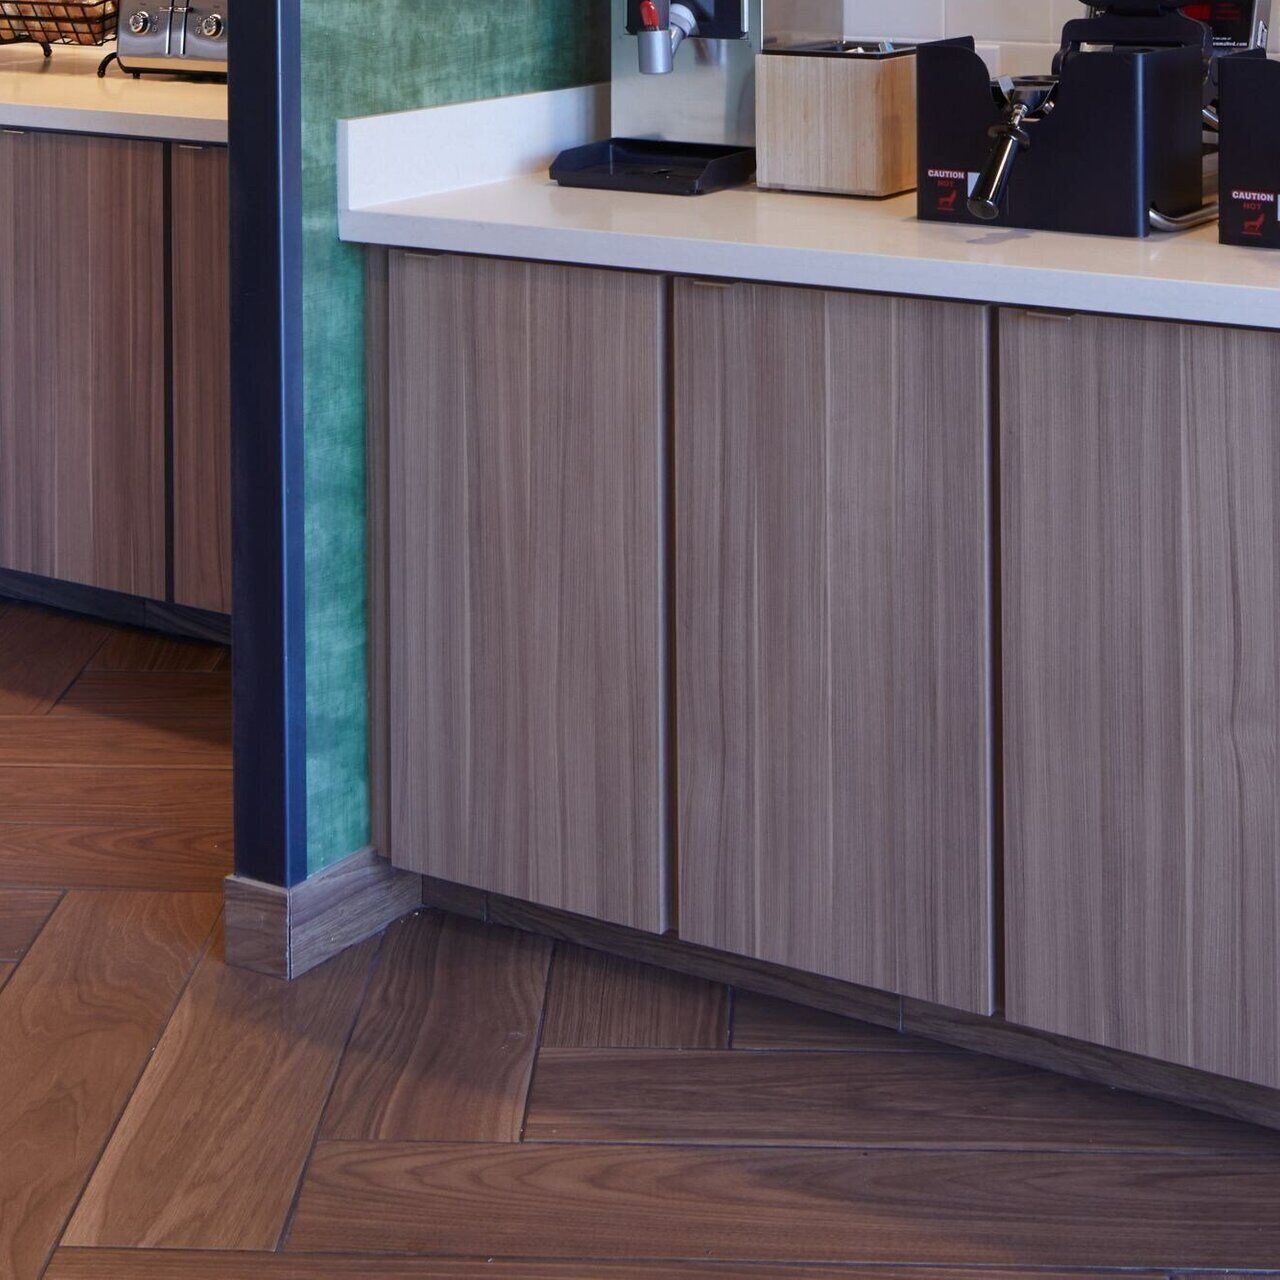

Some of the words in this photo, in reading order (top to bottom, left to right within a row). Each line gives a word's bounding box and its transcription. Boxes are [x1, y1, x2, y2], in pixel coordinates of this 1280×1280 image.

[928, 169, 965, 179] CAUTION
[1232, 191, 1274, 202] CAUTION
[1243, 202, 1262, 210] HOT
